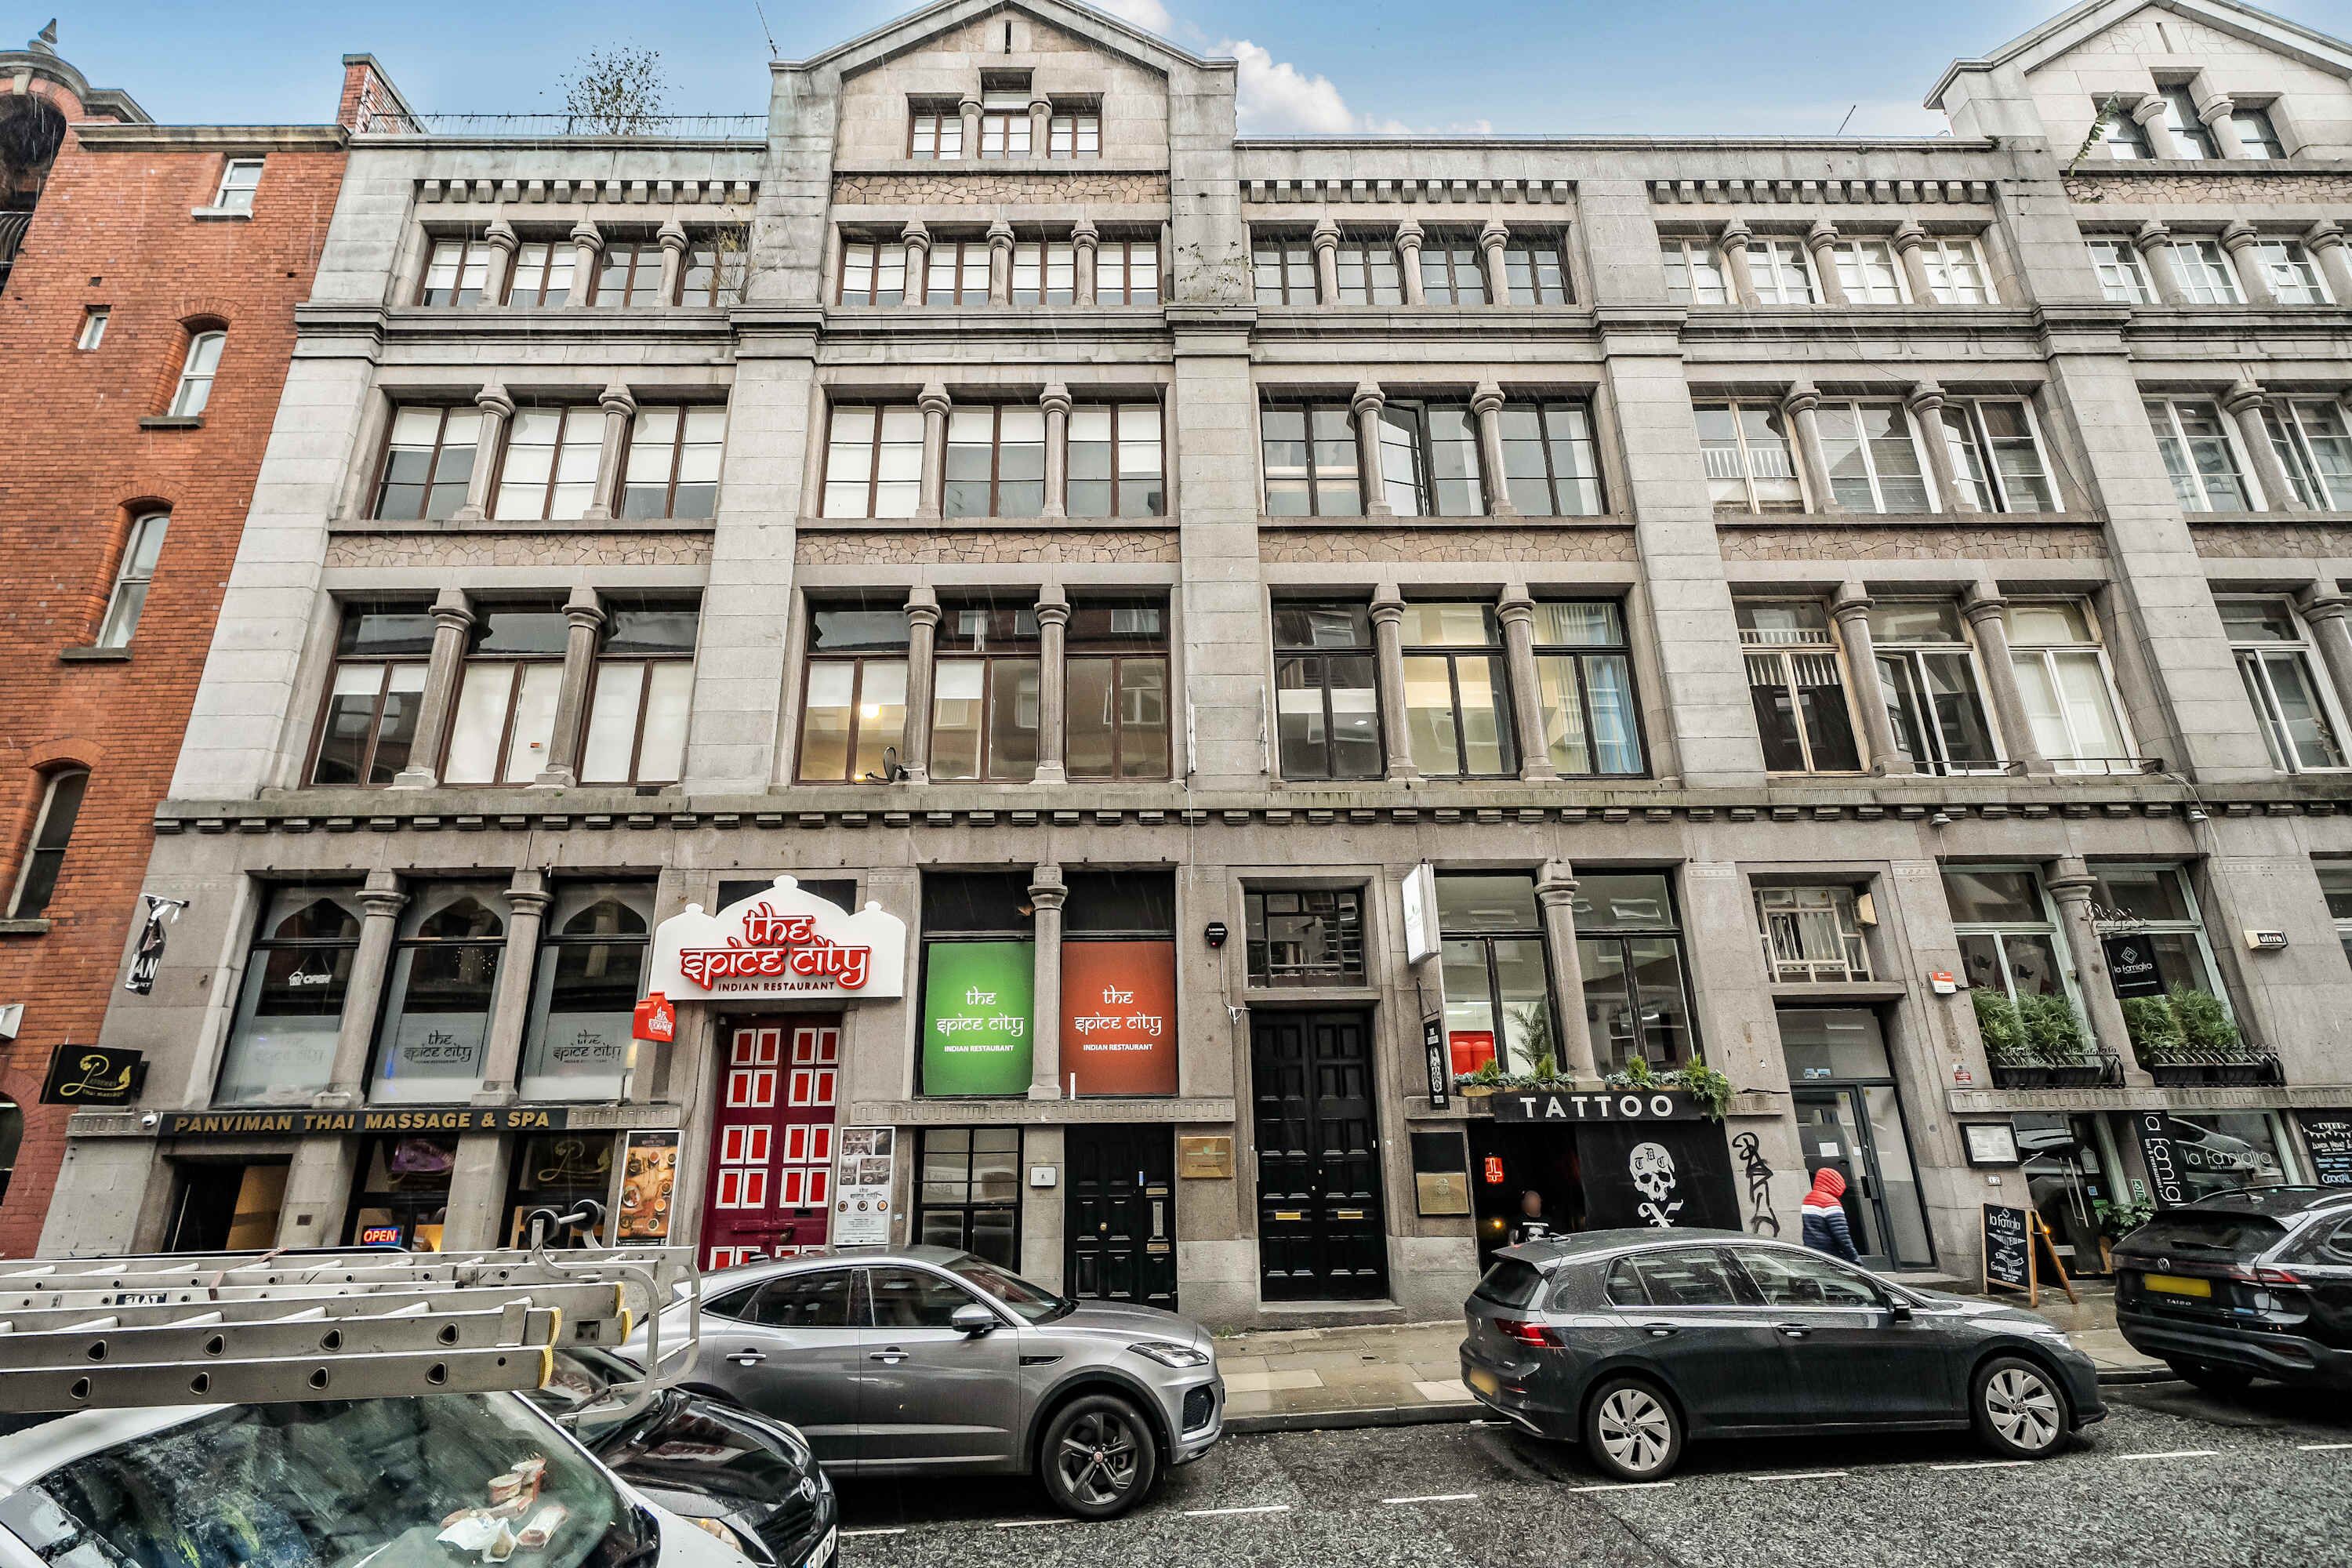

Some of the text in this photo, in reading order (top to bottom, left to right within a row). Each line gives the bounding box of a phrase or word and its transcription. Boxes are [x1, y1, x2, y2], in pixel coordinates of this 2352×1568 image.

[742, 902, 815, 944] the
[681, 936, 871, 989] spice city
[303, 975, 332, 984] OPEN
[718, 981, 835, 992] INDIAN RESTAURANT
[965, 985, 997, 1005] the
[1102, 984, 1134, 1004] the
[935, 1012, 1025, 1037] spice city
[1073, 1011, 1163, 1036] spice city
[426, 1029, 454, 1045] the
[403, 1042, 473, 1062] spice city
[552, 1041, 622, 1062] spice city
[1519, 1094, 1674, 1119] TATTOO
[173, 1111, 550, 1133] PANVIMAN THAI MASSAGE & SPA
[2143, 1112, 2183, 1206] la famigl
[2183, 1149, 2273, 1169] la famiglia
[363, 1229, 398, 1243] OPEN
